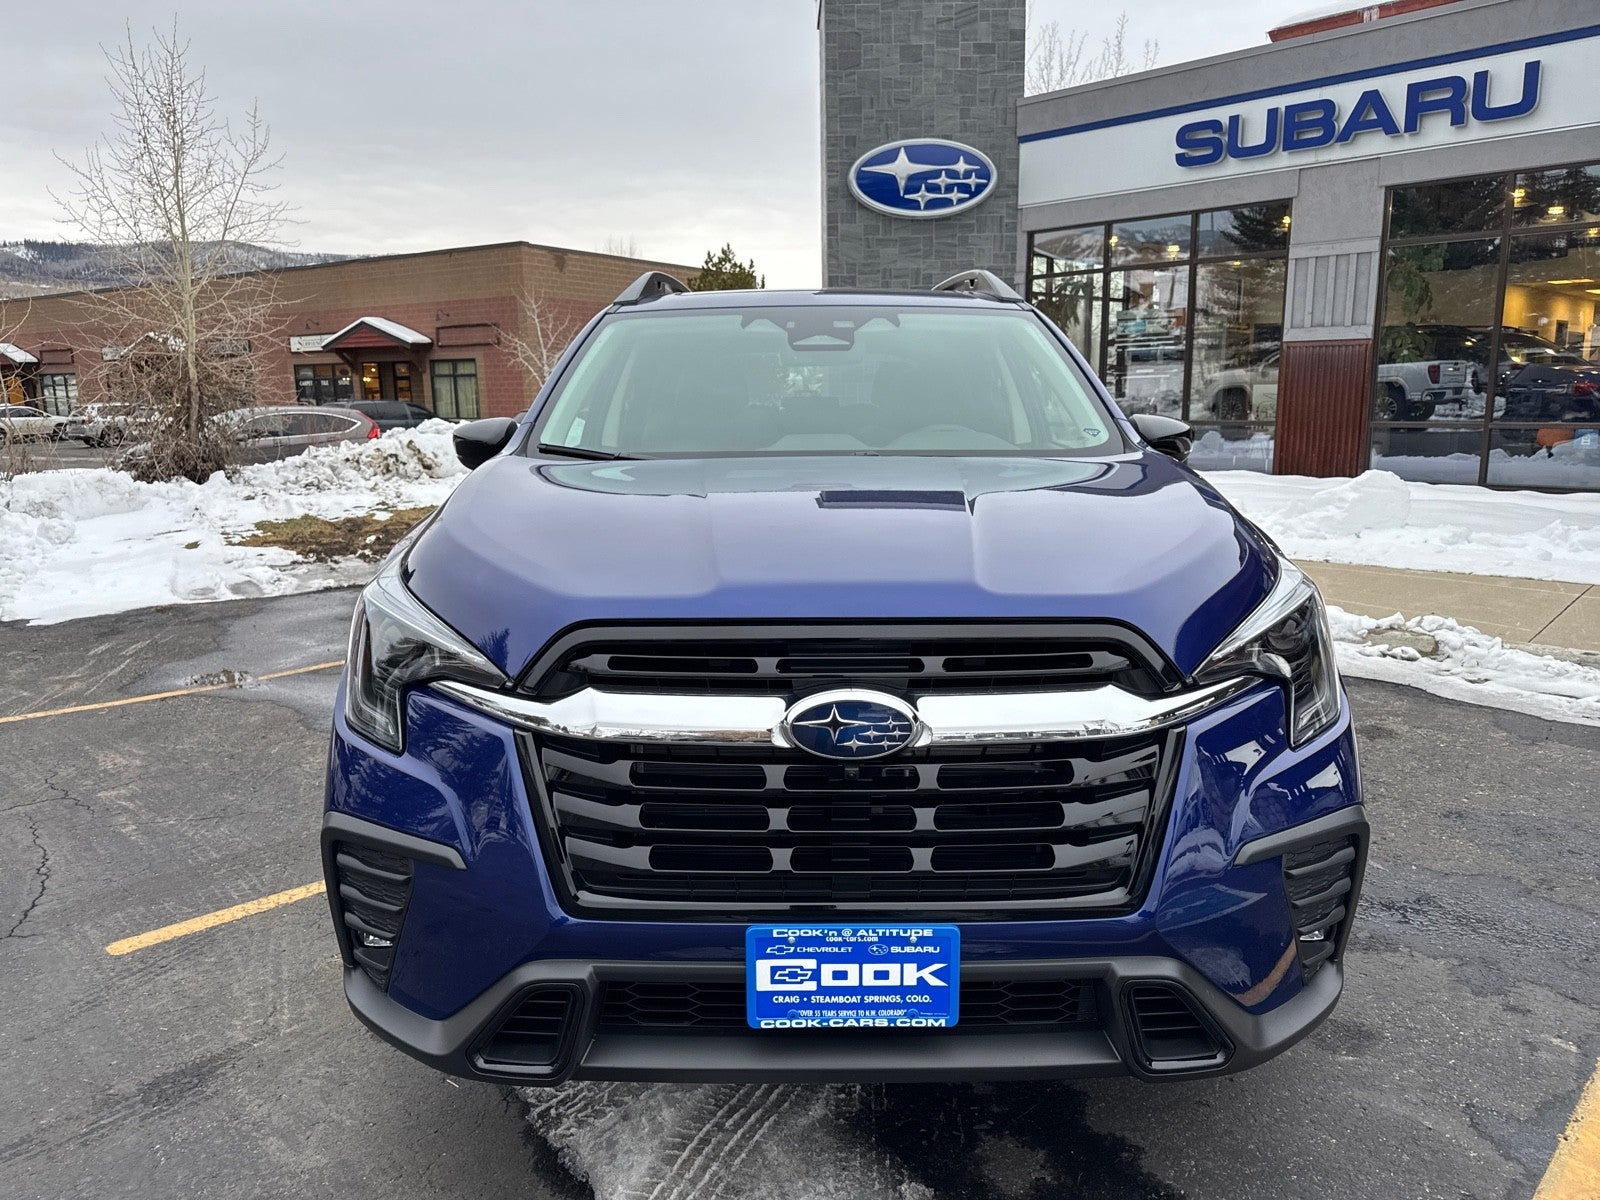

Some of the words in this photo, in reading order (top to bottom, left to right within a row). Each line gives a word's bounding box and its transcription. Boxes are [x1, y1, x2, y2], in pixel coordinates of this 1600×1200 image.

[1175, 60, 1542, 168] SUBARU
[841, 928, 853, 937] @
[856, 929, 934, 937] ALTITUDE
[756, 959, 948, 991] COOK
[772, 995, 800, 1004] CRAIG
[810, 995, 862, 1004] STEAMBOAT
[863, 994, 904, 1004] SPRINGS,
[905, 994, 933, 1003] COLO.
[814, 1009, 821, 1017] 55
[821, 1009, 836, 1017] YEARS
[837, 1009, 857, 1017] SERVICE
[858, 1009, 865, 1017] TO
[760, 1018, 946, 1029] COOK-CARS.COM
